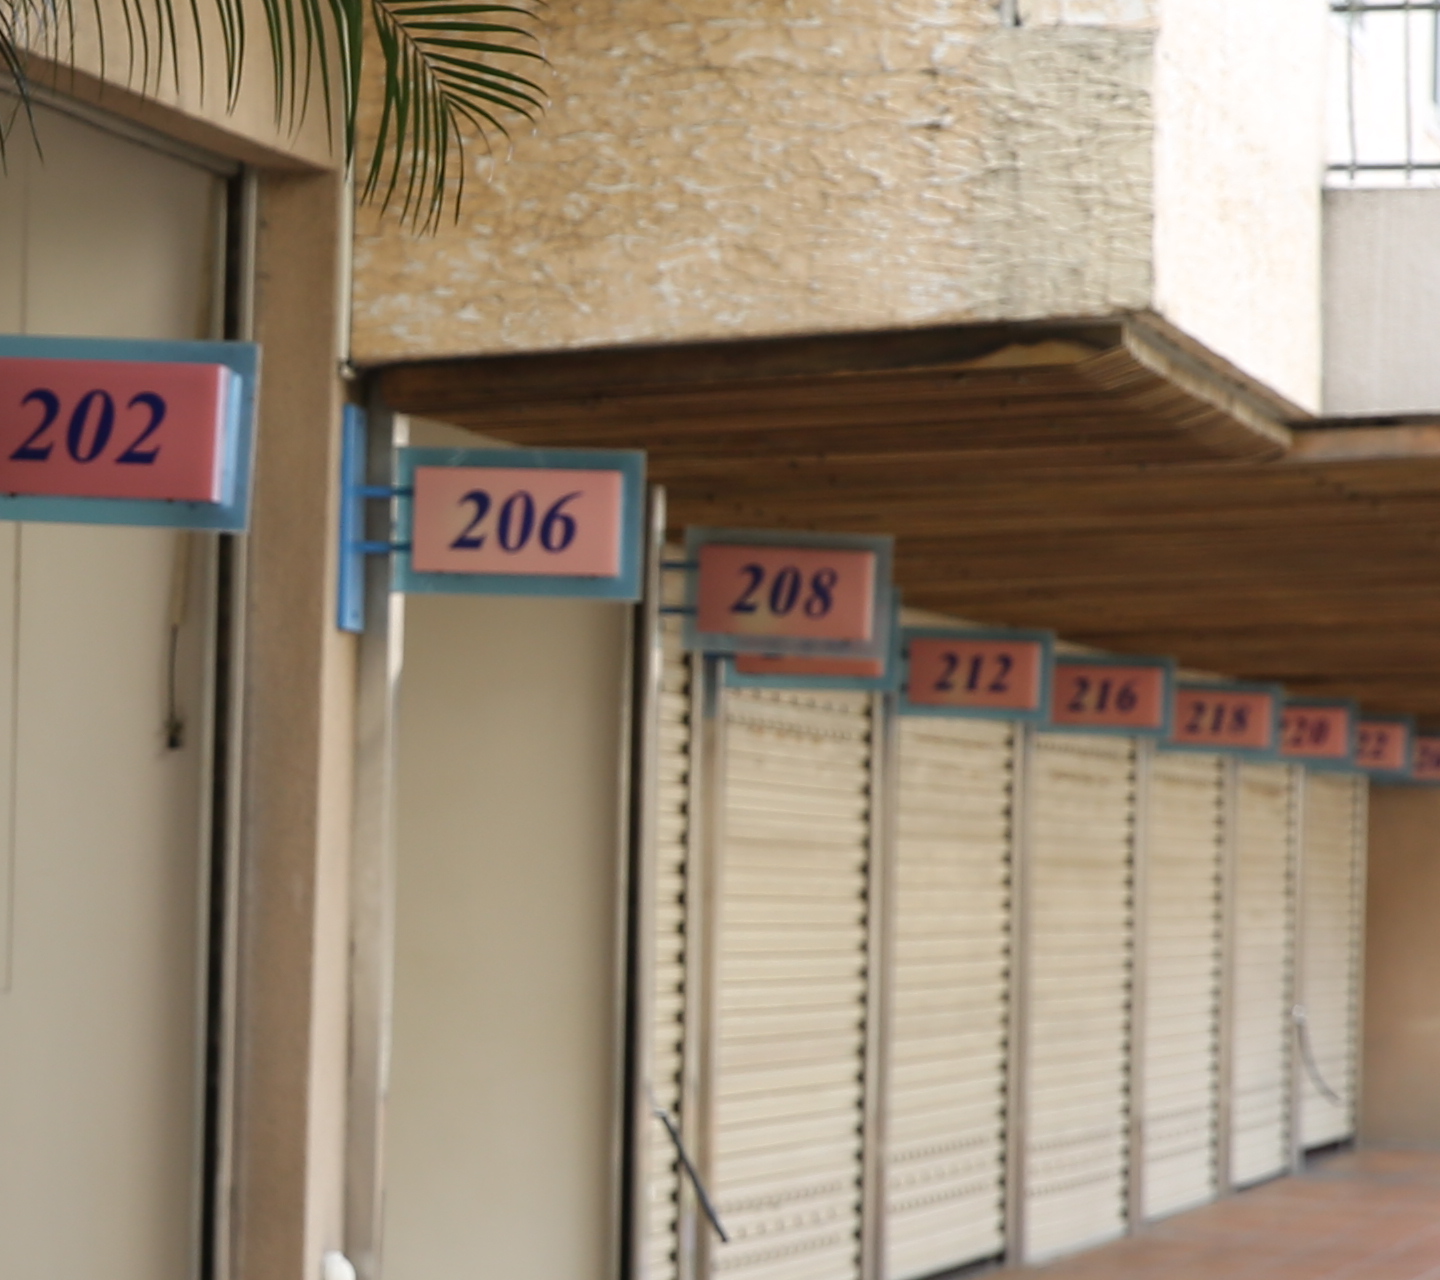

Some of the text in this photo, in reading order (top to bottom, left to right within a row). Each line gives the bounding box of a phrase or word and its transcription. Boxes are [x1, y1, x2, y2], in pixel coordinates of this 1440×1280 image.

[9, 388, 168, 465] 202
[449, 490, 583, 553] 206
[730, 563, 839, 619] 208
[934, 652, 1013, 693] 212
[1067, 676, 1137, 713] 216
[1185, 701, 1251, 734] 218
